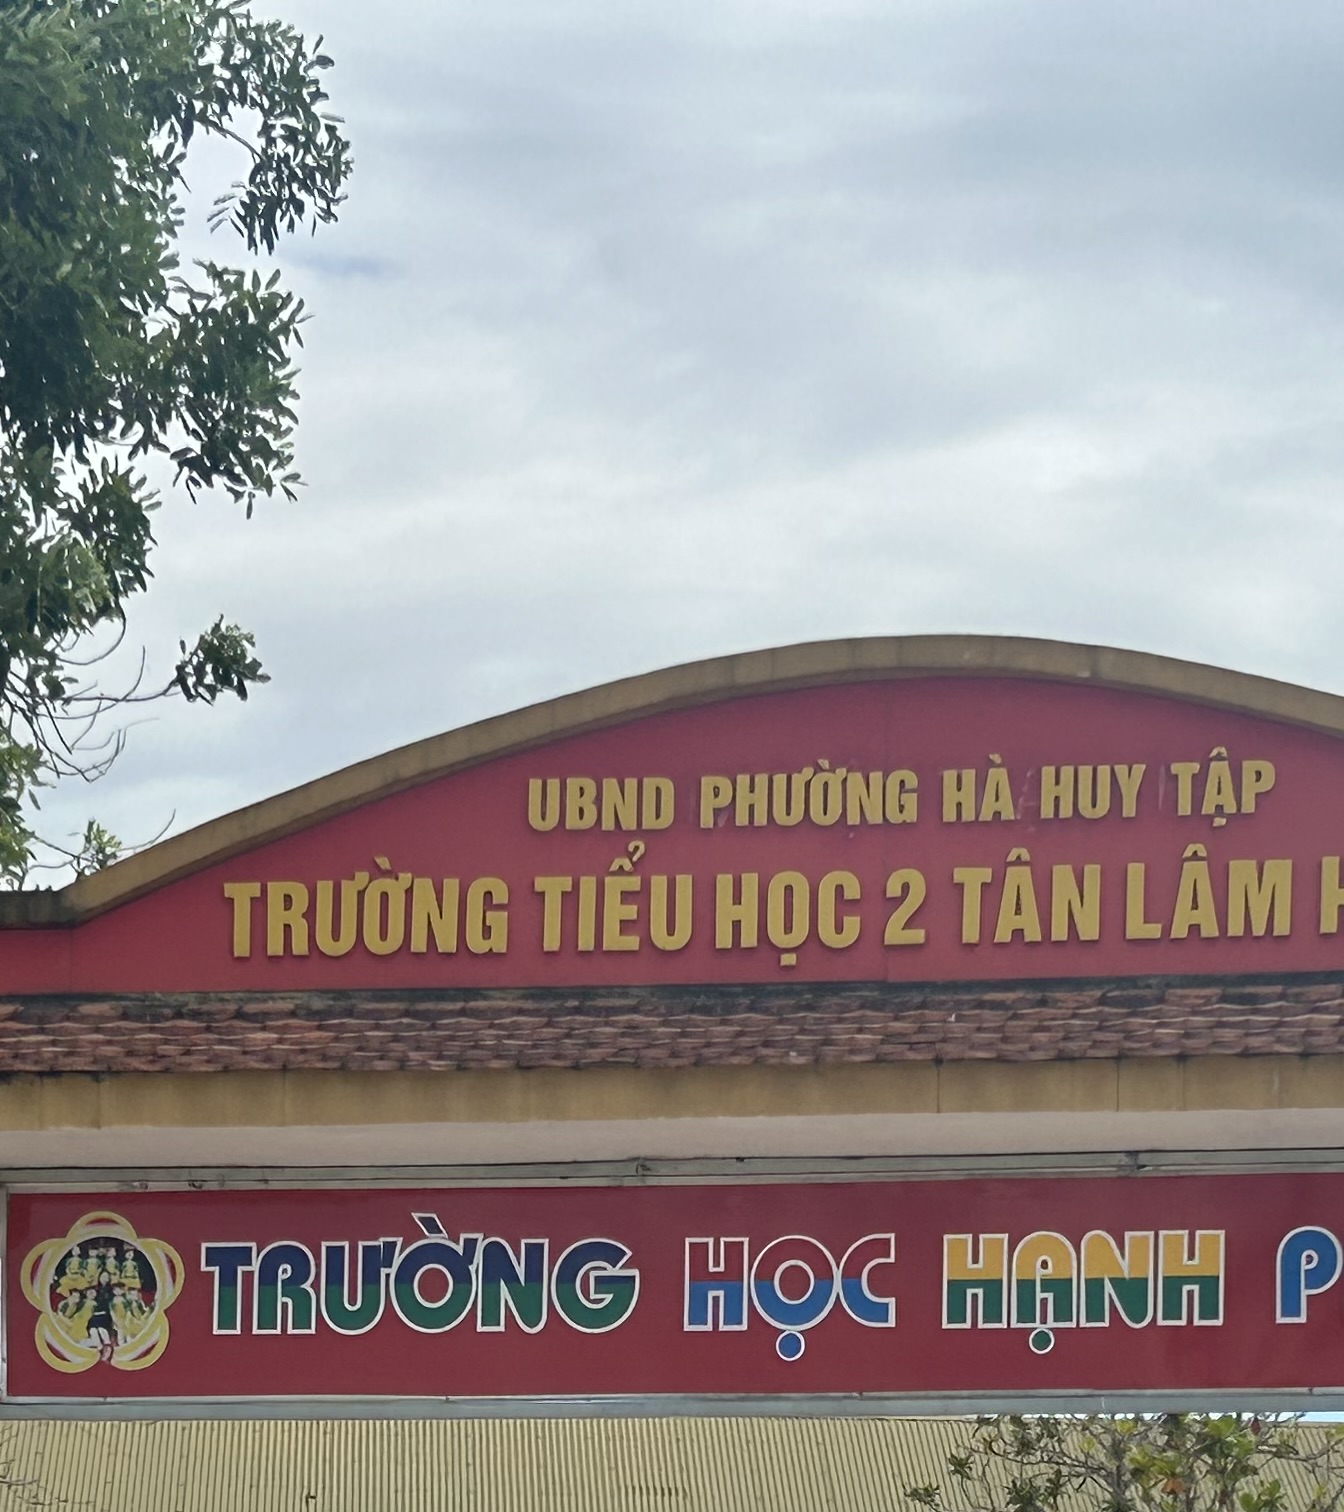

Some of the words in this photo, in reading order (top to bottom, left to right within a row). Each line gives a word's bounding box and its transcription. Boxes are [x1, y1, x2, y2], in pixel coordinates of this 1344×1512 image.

[528, 777, 675, 831] UBND
[699, 758, 919, 828] PHƯỜNG
[942, 753, 1016, 822] HÀ
[1040, 763, 1146, 819] HUY
[1170, 746, 1276, 827] TẬP
[223, 855, 509, 958] TRƯỜNG
[534, 840, 693, 952] TIỂU
[714, 871, 862, 966] HỌC
[884, 868, 926, 944] 2
[953, 847, 1101, 944] TÂN
[1125, 842, 1293, 940] LÂM
[200, 1212, 639, 1334] TRƯỜNG
[683, 1233, 895, 1361] HỌC
[942, 1230, 1225, 1353] HẠNH
